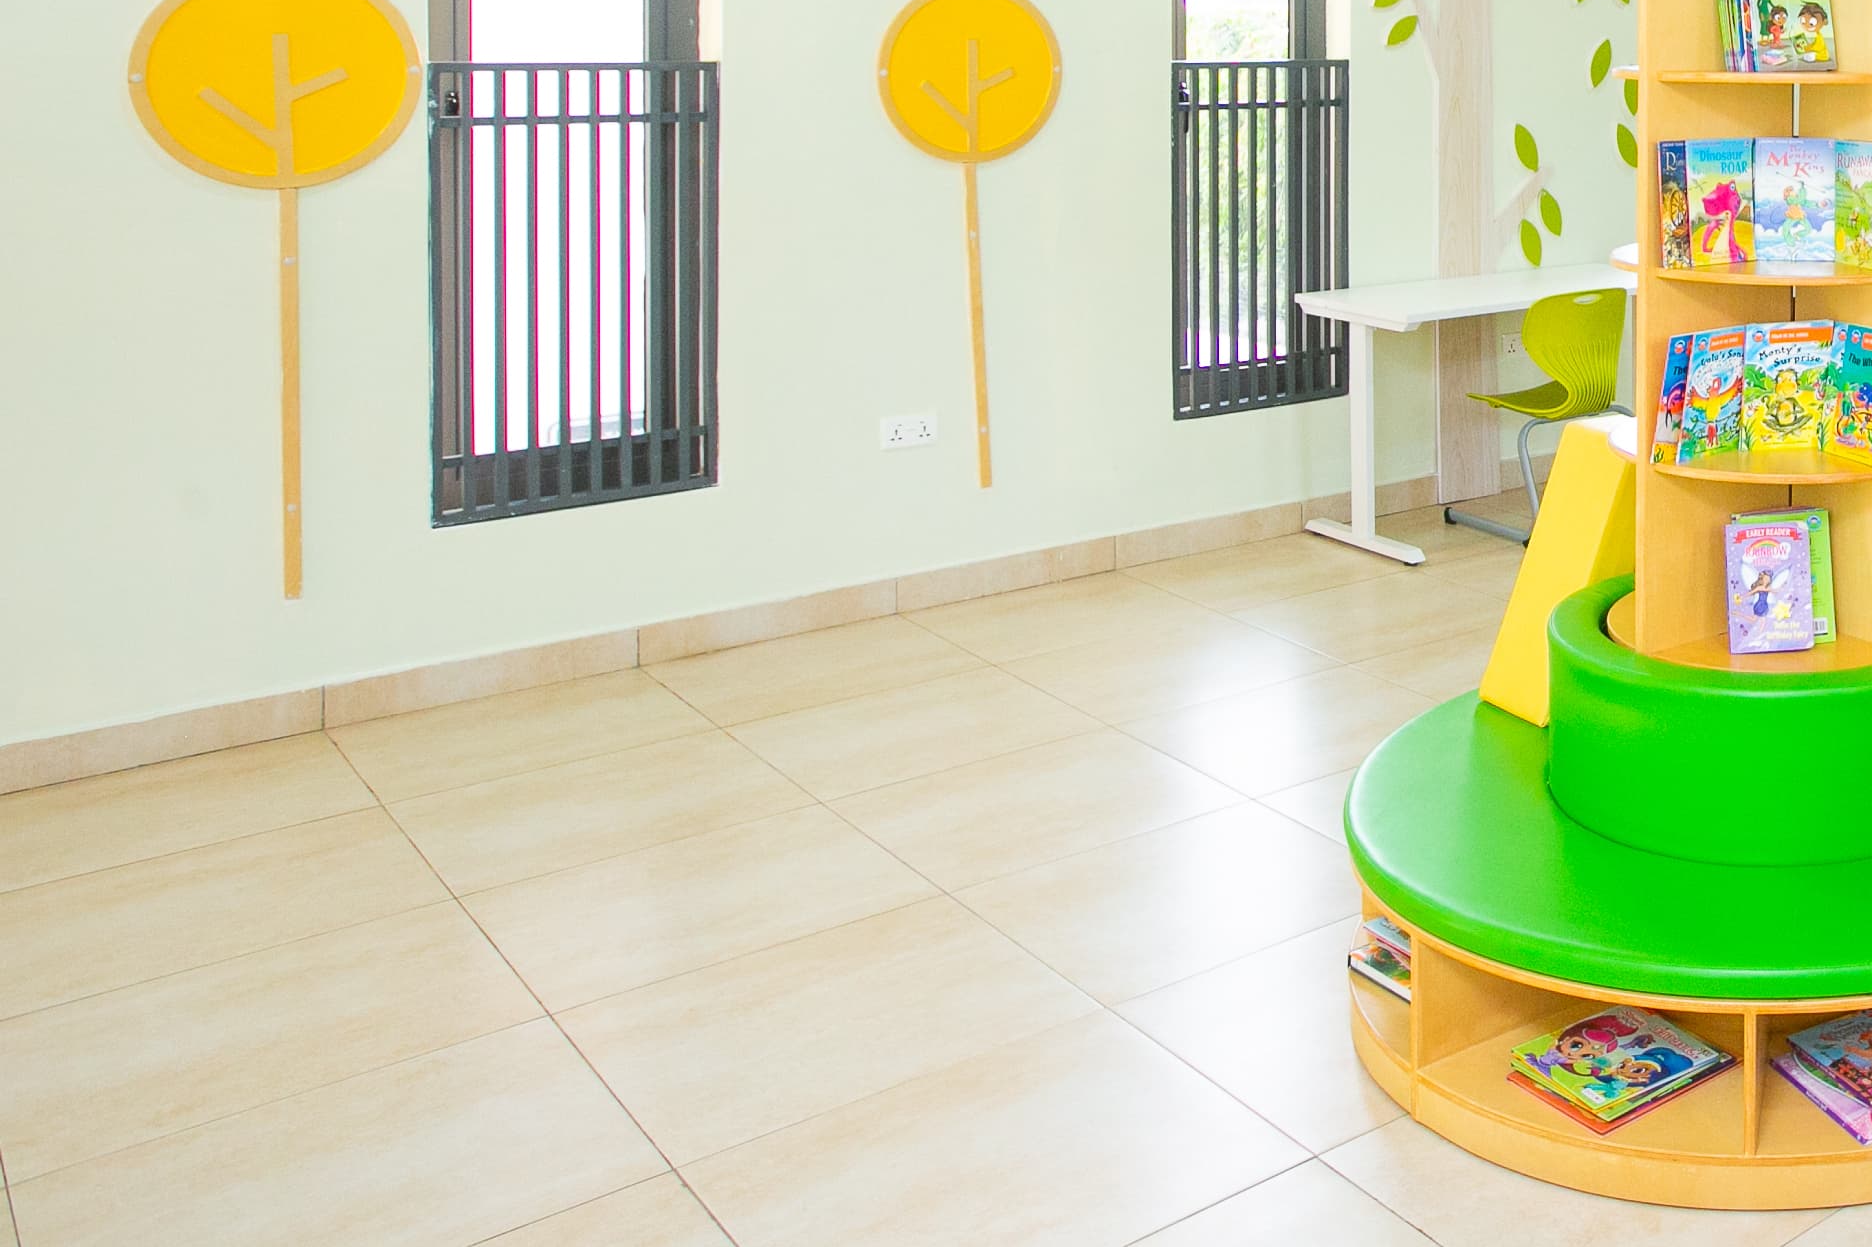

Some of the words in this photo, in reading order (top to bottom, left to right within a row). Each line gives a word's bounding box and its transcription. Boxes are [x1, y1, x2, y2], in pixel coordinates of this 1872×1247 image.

[1721, 160, 1748, 175] ROAR
[1759, 344, 1802, 360] Monty's
[1773, 356, 1821, 368] Surprise
[1849, 353, 1860, 365] The
